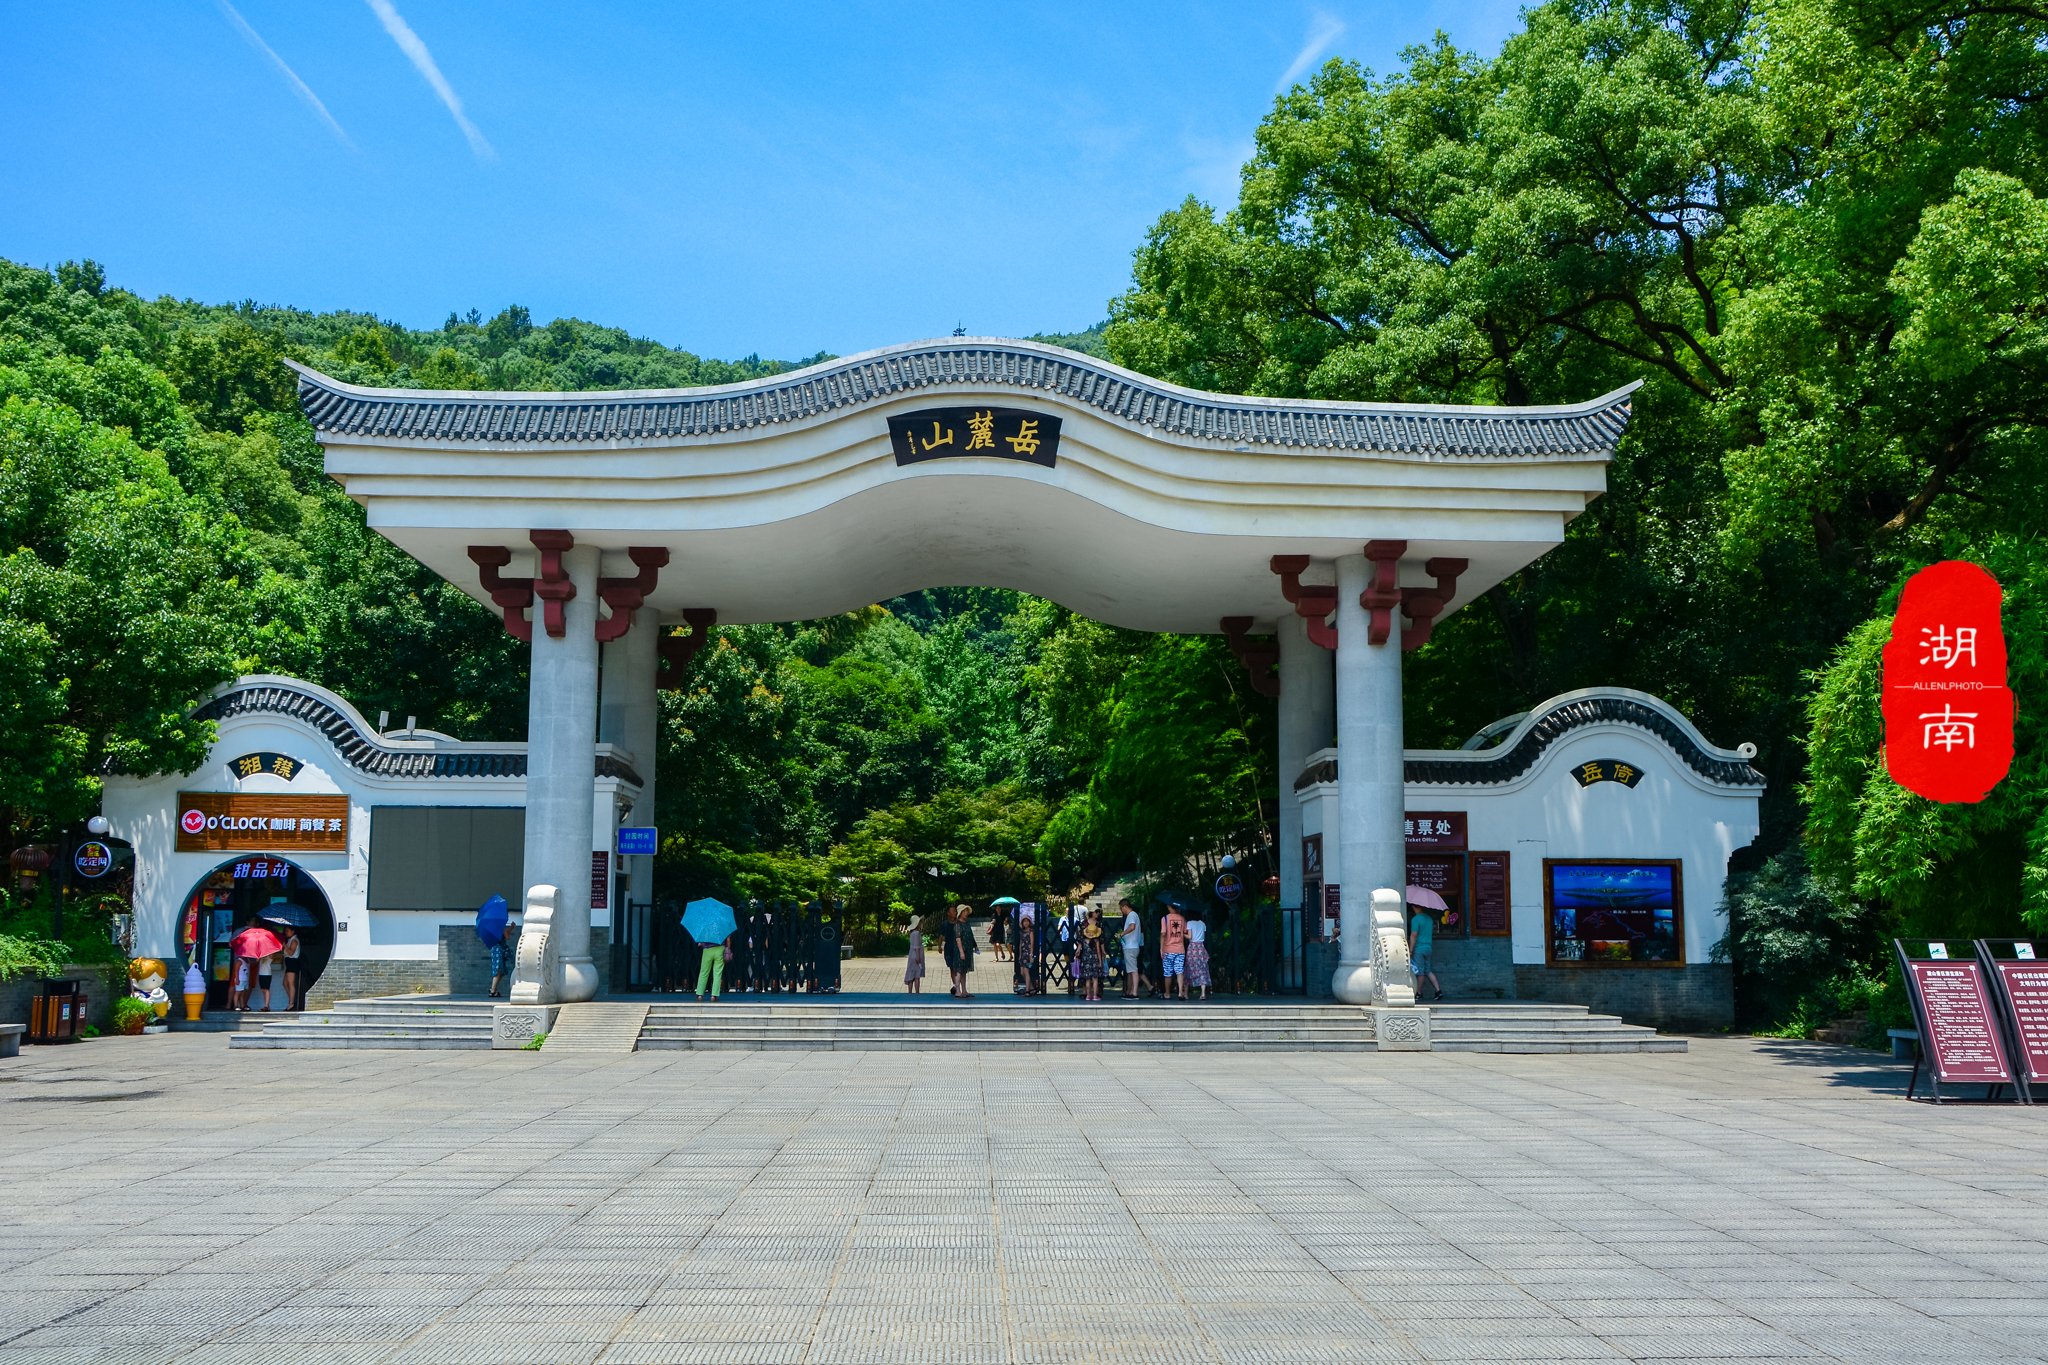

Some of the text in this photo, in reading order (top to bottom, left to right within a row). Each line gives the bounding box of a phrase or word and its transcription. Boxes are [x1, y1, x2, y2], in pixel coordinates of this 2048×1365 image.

[921, 409, 1041, 456] 岳麓山
[233, 862, 290, 878] 甜品站
